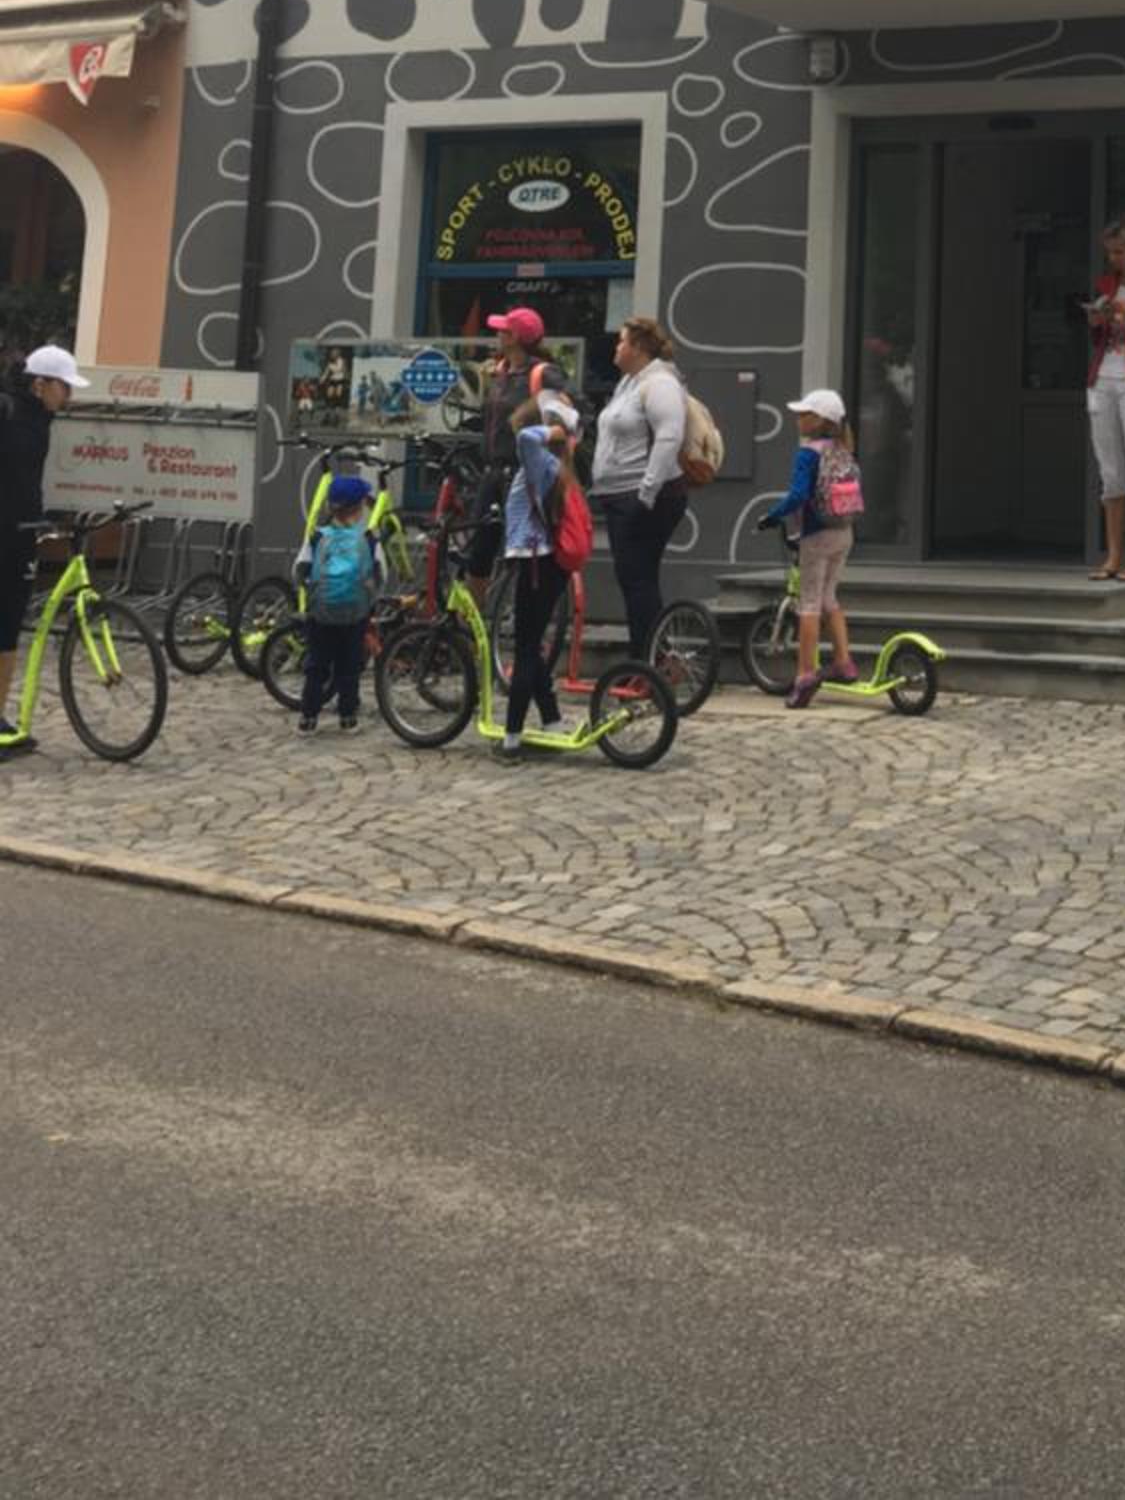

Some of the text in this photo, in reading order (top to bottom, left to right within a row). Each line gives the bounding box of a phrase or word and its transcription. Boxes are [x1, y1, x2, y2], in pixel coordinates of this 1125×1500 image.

[518, 186, 562, 203] OTRE
[436, 182, 483, 260] SPORT
[498, 155, 571, 182] CYKLO
[584, 172, 637, 260] PRODEJ
[143, 442, 195, 460] Penzion
[159, 459, 238, 479] Restaurant
